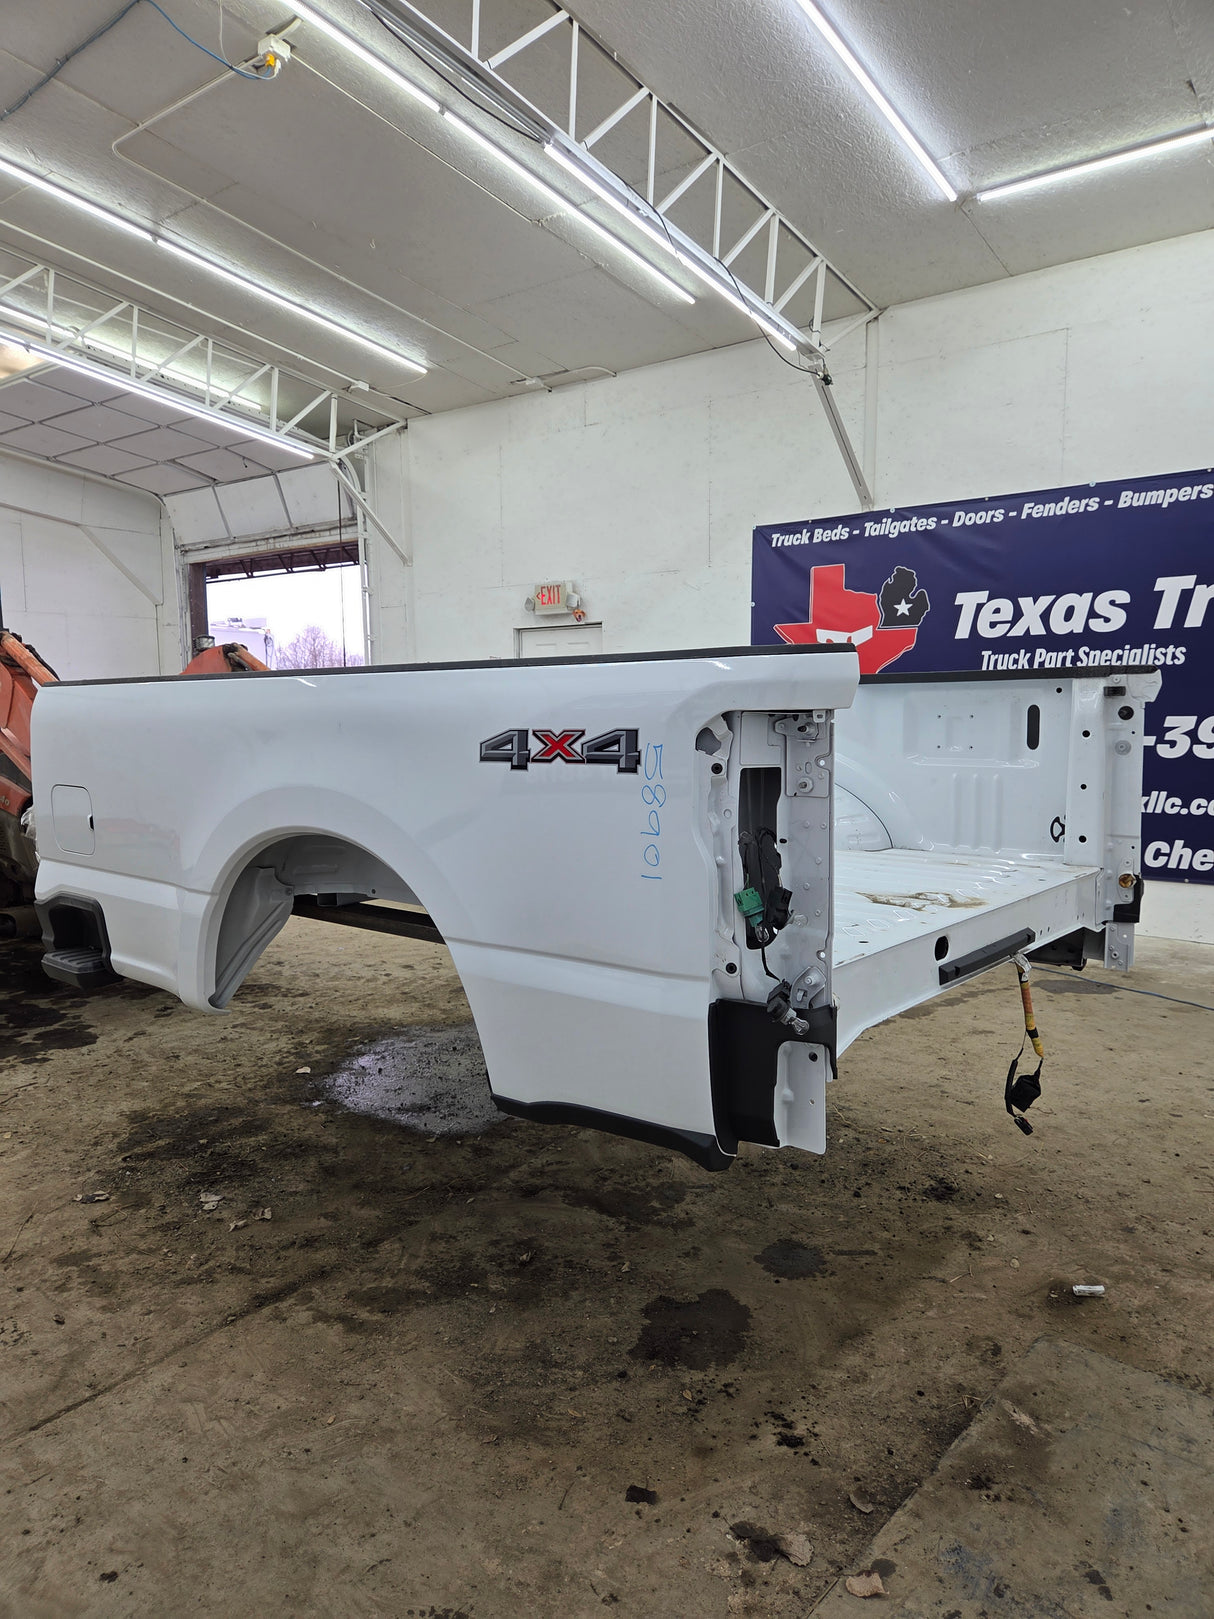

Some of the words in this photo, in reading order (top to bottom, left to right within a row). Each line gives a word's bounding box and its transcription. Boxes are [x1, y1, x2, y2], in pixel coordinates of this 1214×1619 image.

[771, 529, 810, 547] Truck
[813, 525, 850, 543] Beds
[864, 516, 937, 538] Tailgates
[952, 508, 1005, 527] Doors
[1021, 496, 1100, 519] Fenders
[1117, 483, 1214, 508] Bumpers
[541, 584, 561, 605] EXIT
[954, 589, 1131, 639] Texas
[1153, 574, 1214, 630] Tr
[981, 649, 1032, 671] Truck
[1033, 648, 1075, 669] Part
[1076, 643, 1187, 667] Specialists
